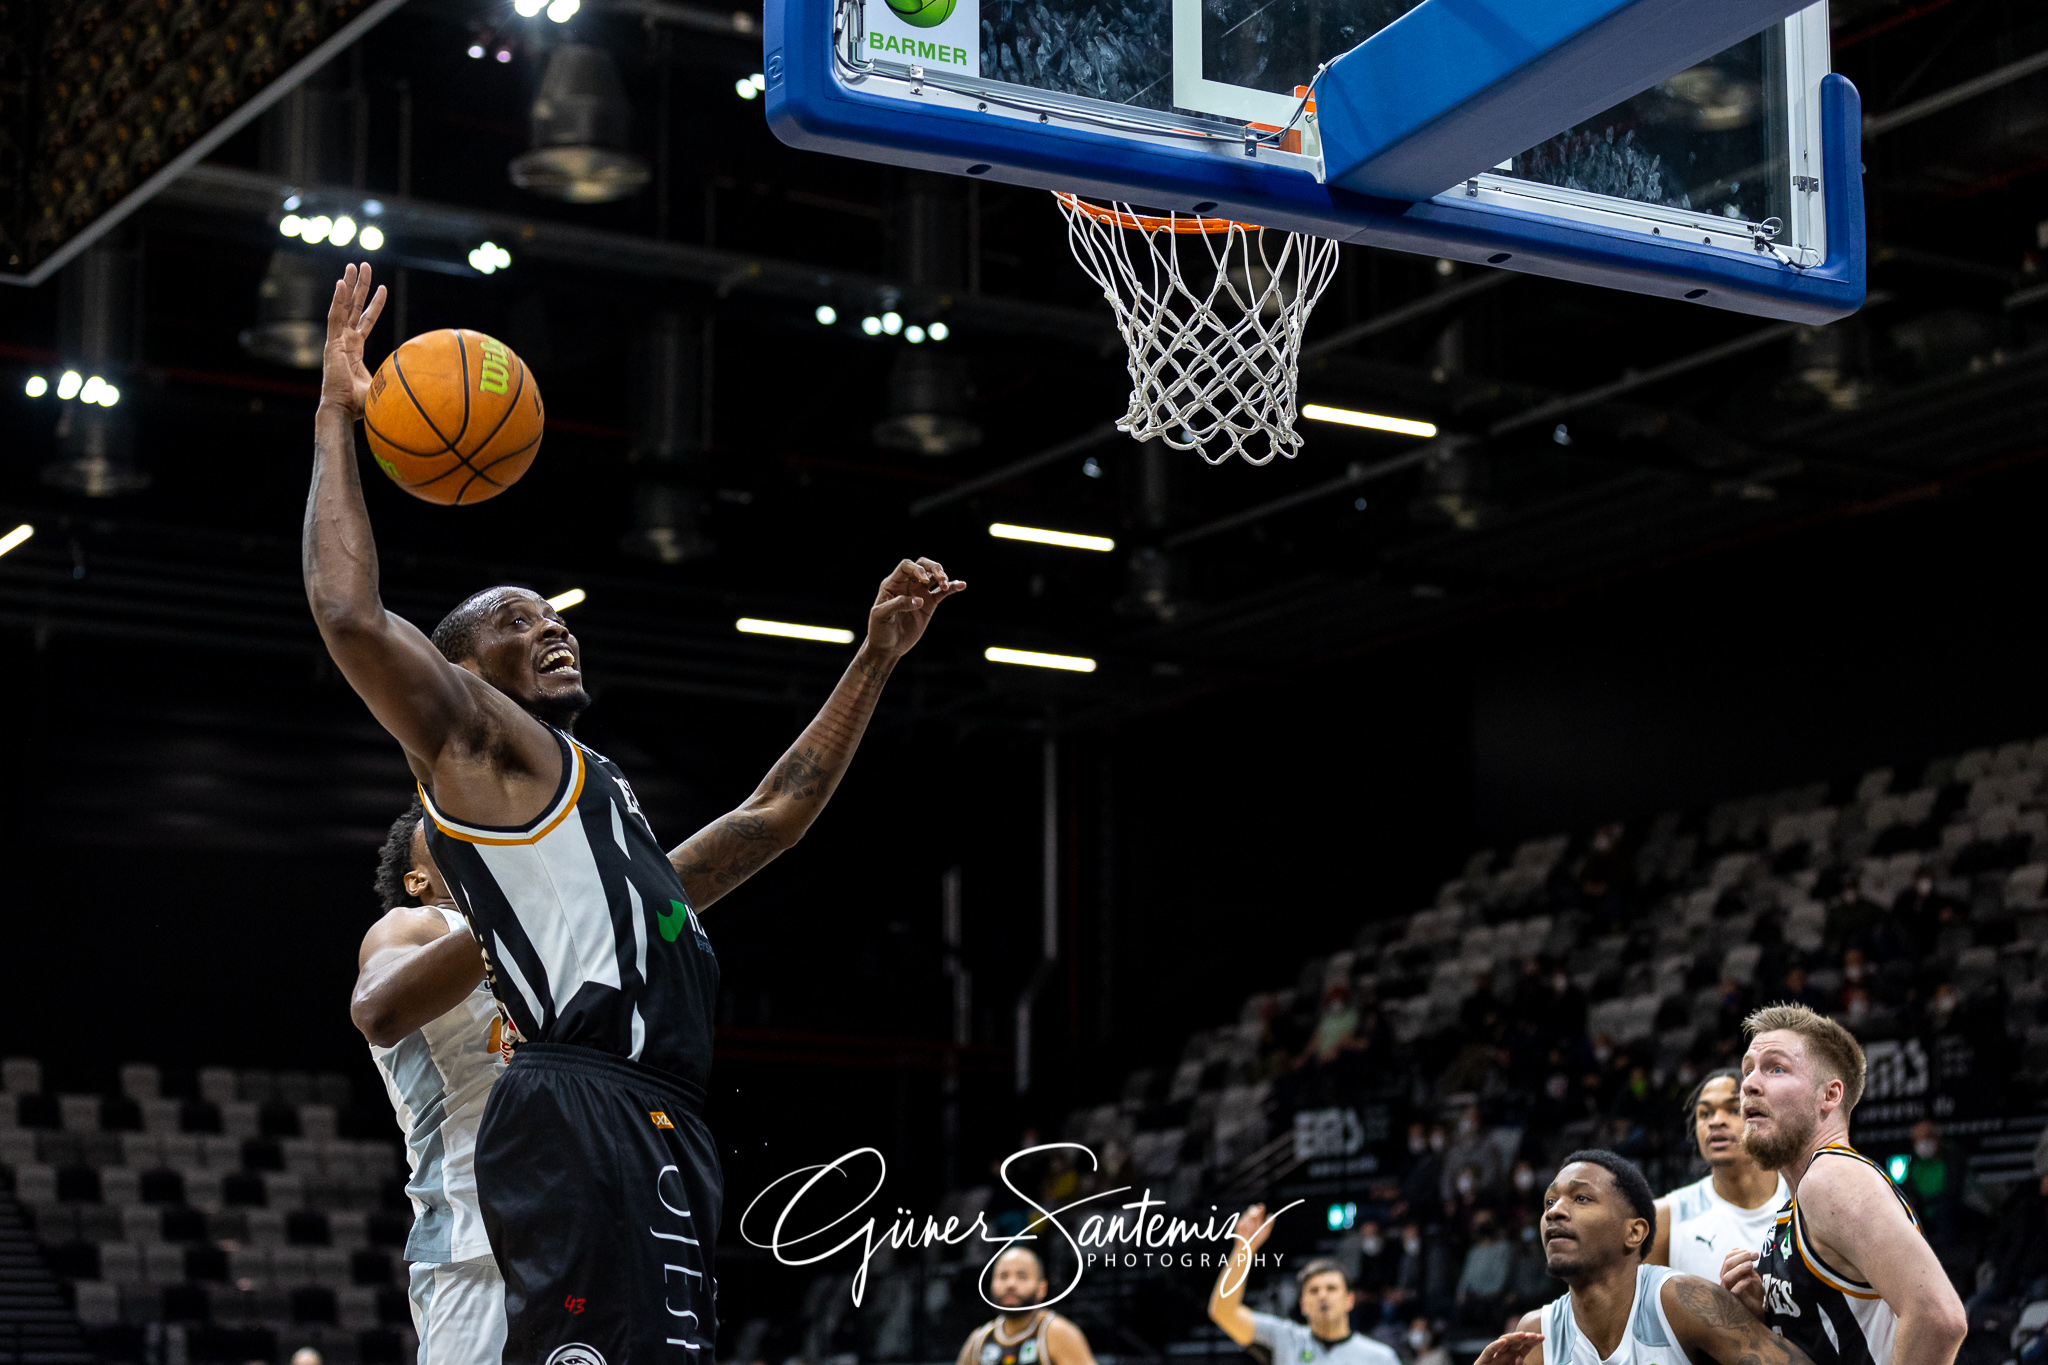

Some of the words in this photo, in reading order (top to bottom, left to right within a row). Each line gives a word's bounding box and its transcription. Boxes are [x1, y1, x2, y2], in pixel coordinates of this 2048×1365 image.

[870, 32, 967, 66] BARMER
[656, 1115, 671, 1126] XL
[564, 1294, 587, 1315] 43
